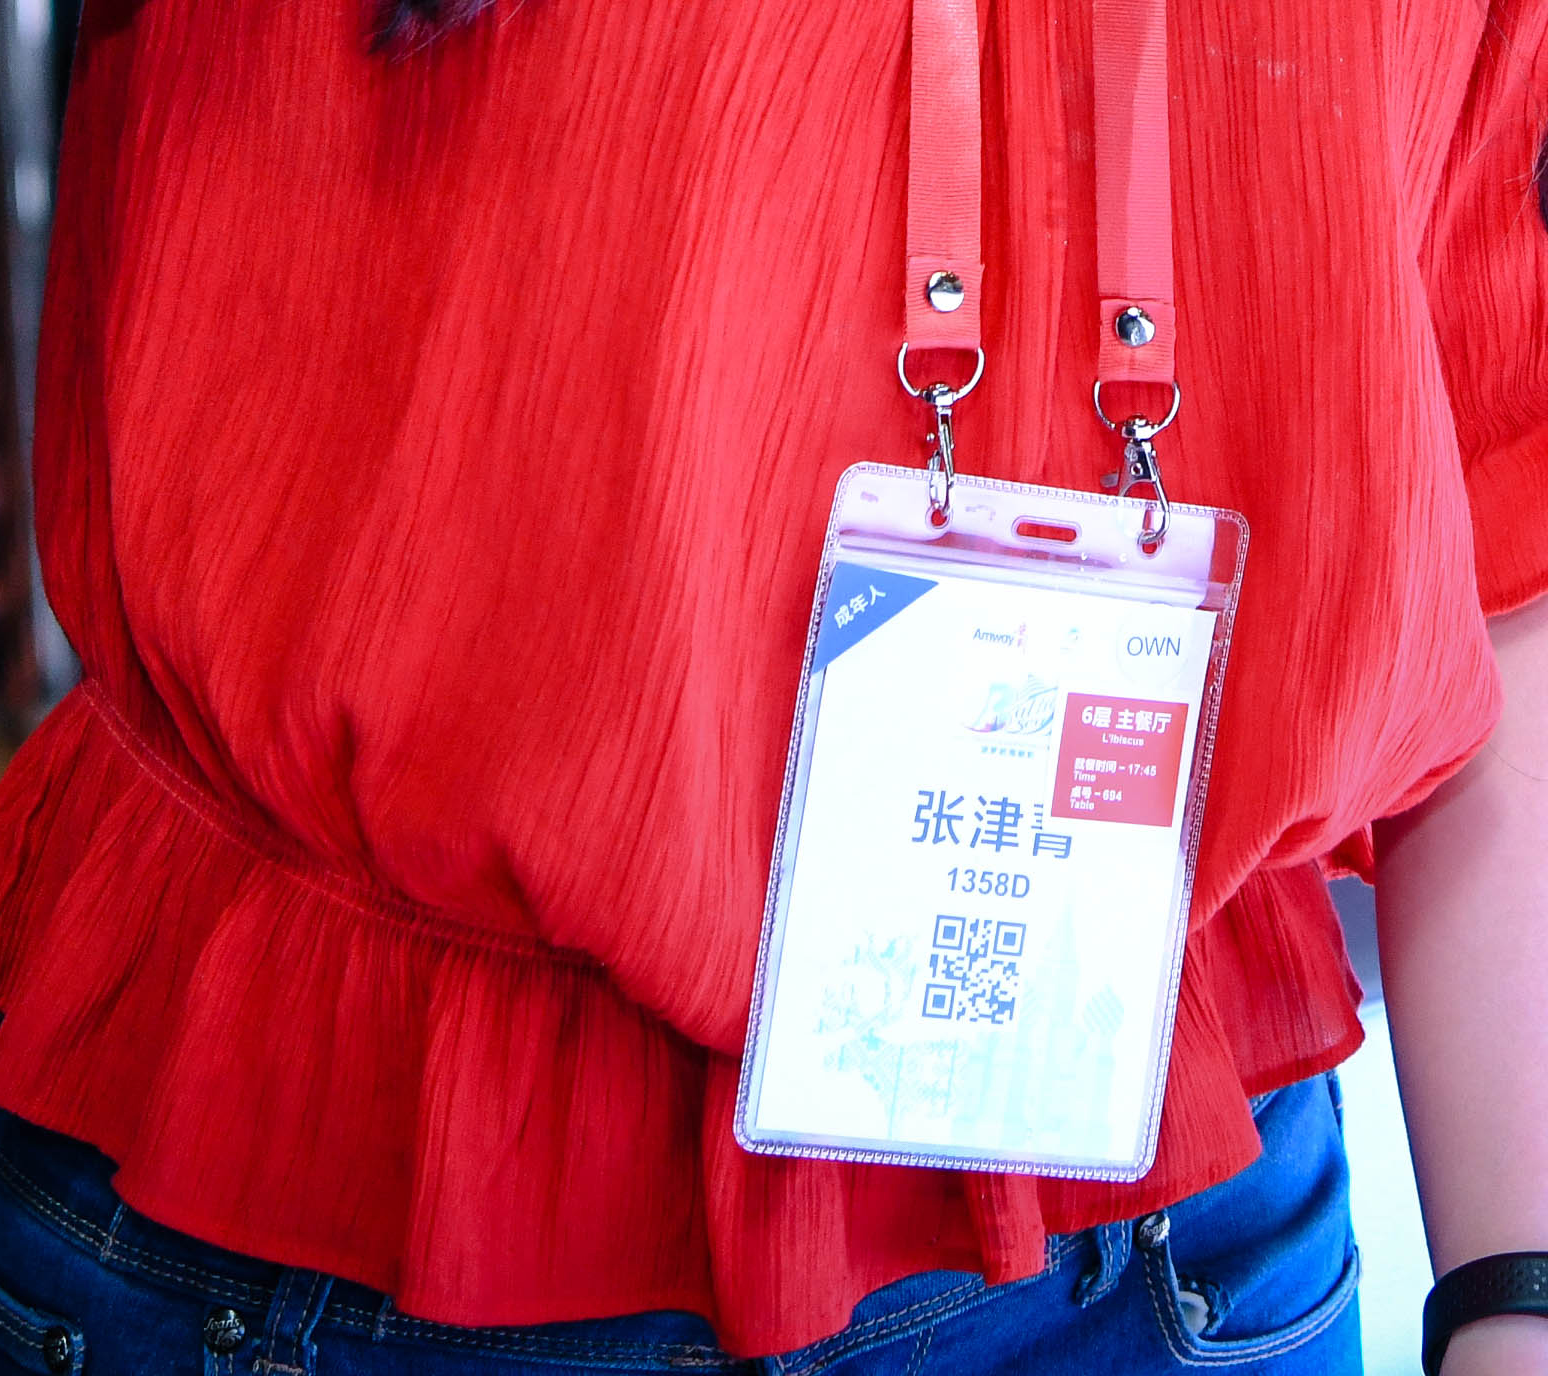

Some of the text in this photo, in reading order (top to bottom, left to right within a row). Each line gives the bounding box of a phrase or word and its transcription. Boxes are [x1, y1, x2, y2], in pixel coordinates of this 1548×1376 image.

[834, 585, 886, 629] 成年人
[973, 628, 1014, 646] Amway
[1127, 636, 1181, 657] OWN
[1081, 706, 1112, 728] 6层
[1115, 709, 1172, 734] 主餐厅
[1073, 770, 1096, 782] Time
[1070, 799, 1095, 811] Table
[947, 867, 1030, 898] 1358D
